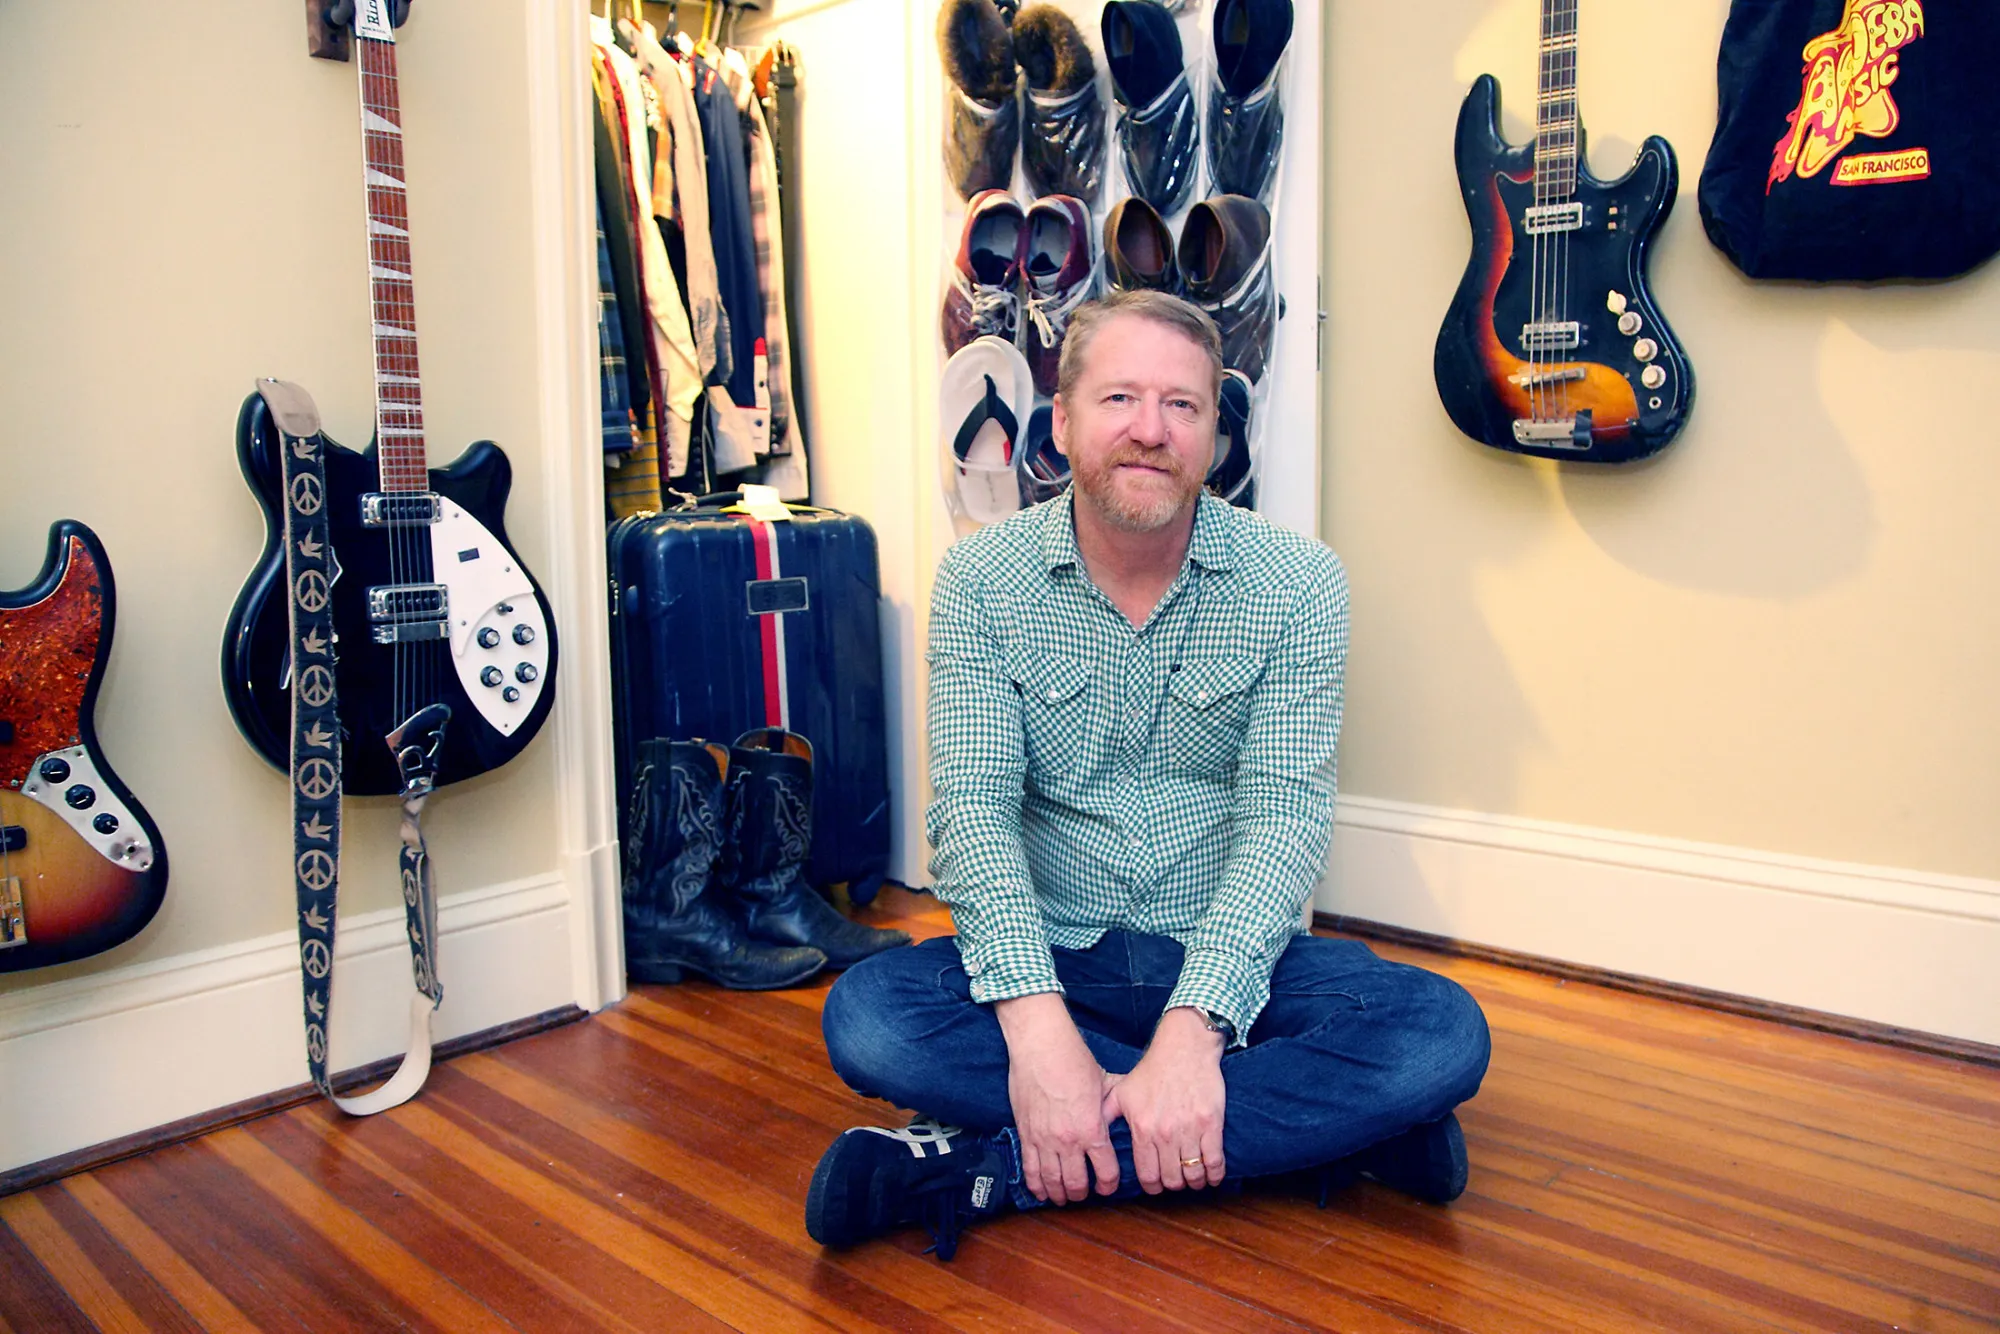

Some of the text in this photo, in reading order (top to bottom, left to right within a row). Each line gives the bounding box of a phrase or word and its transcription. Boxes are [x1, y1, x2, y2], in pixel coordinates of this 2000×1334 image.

[367, 0, 380, 26] Ric
[1841, 156, 1926, 176] SAN FRANCISCO
